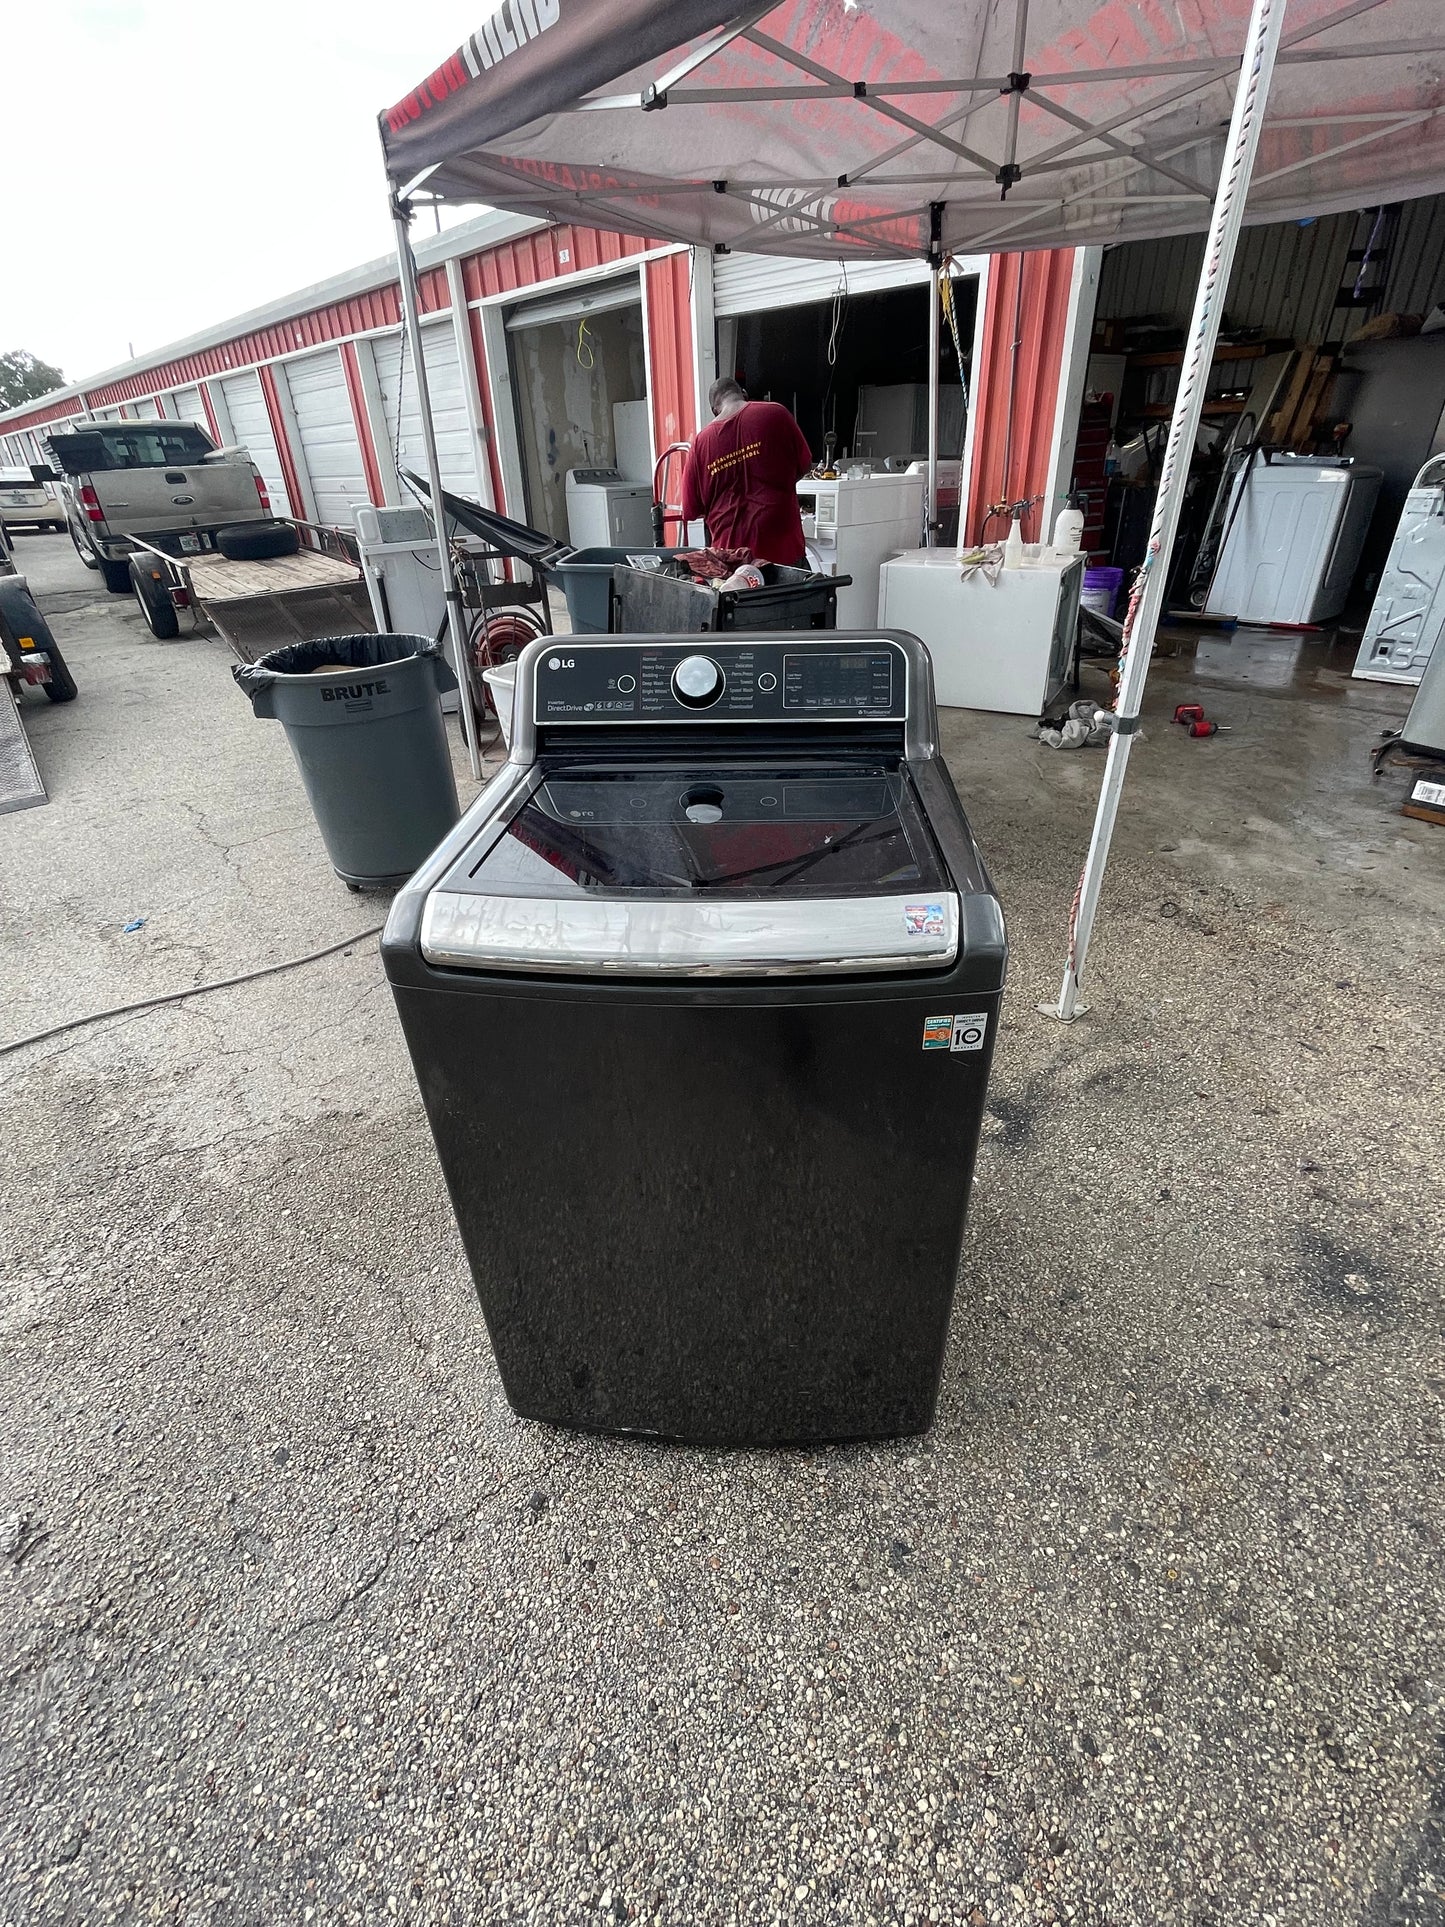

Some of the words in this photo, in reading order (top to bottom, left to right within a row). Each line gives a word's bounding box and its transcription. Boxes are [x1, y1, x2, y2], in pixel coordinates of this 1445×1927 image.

[717, 448, 745, 464] SALVATION
[711, 459, 737, 476] ORLANDO
[320, 680, 391, 701] BRUTE
[954, 1028, 982, 1045] 10
